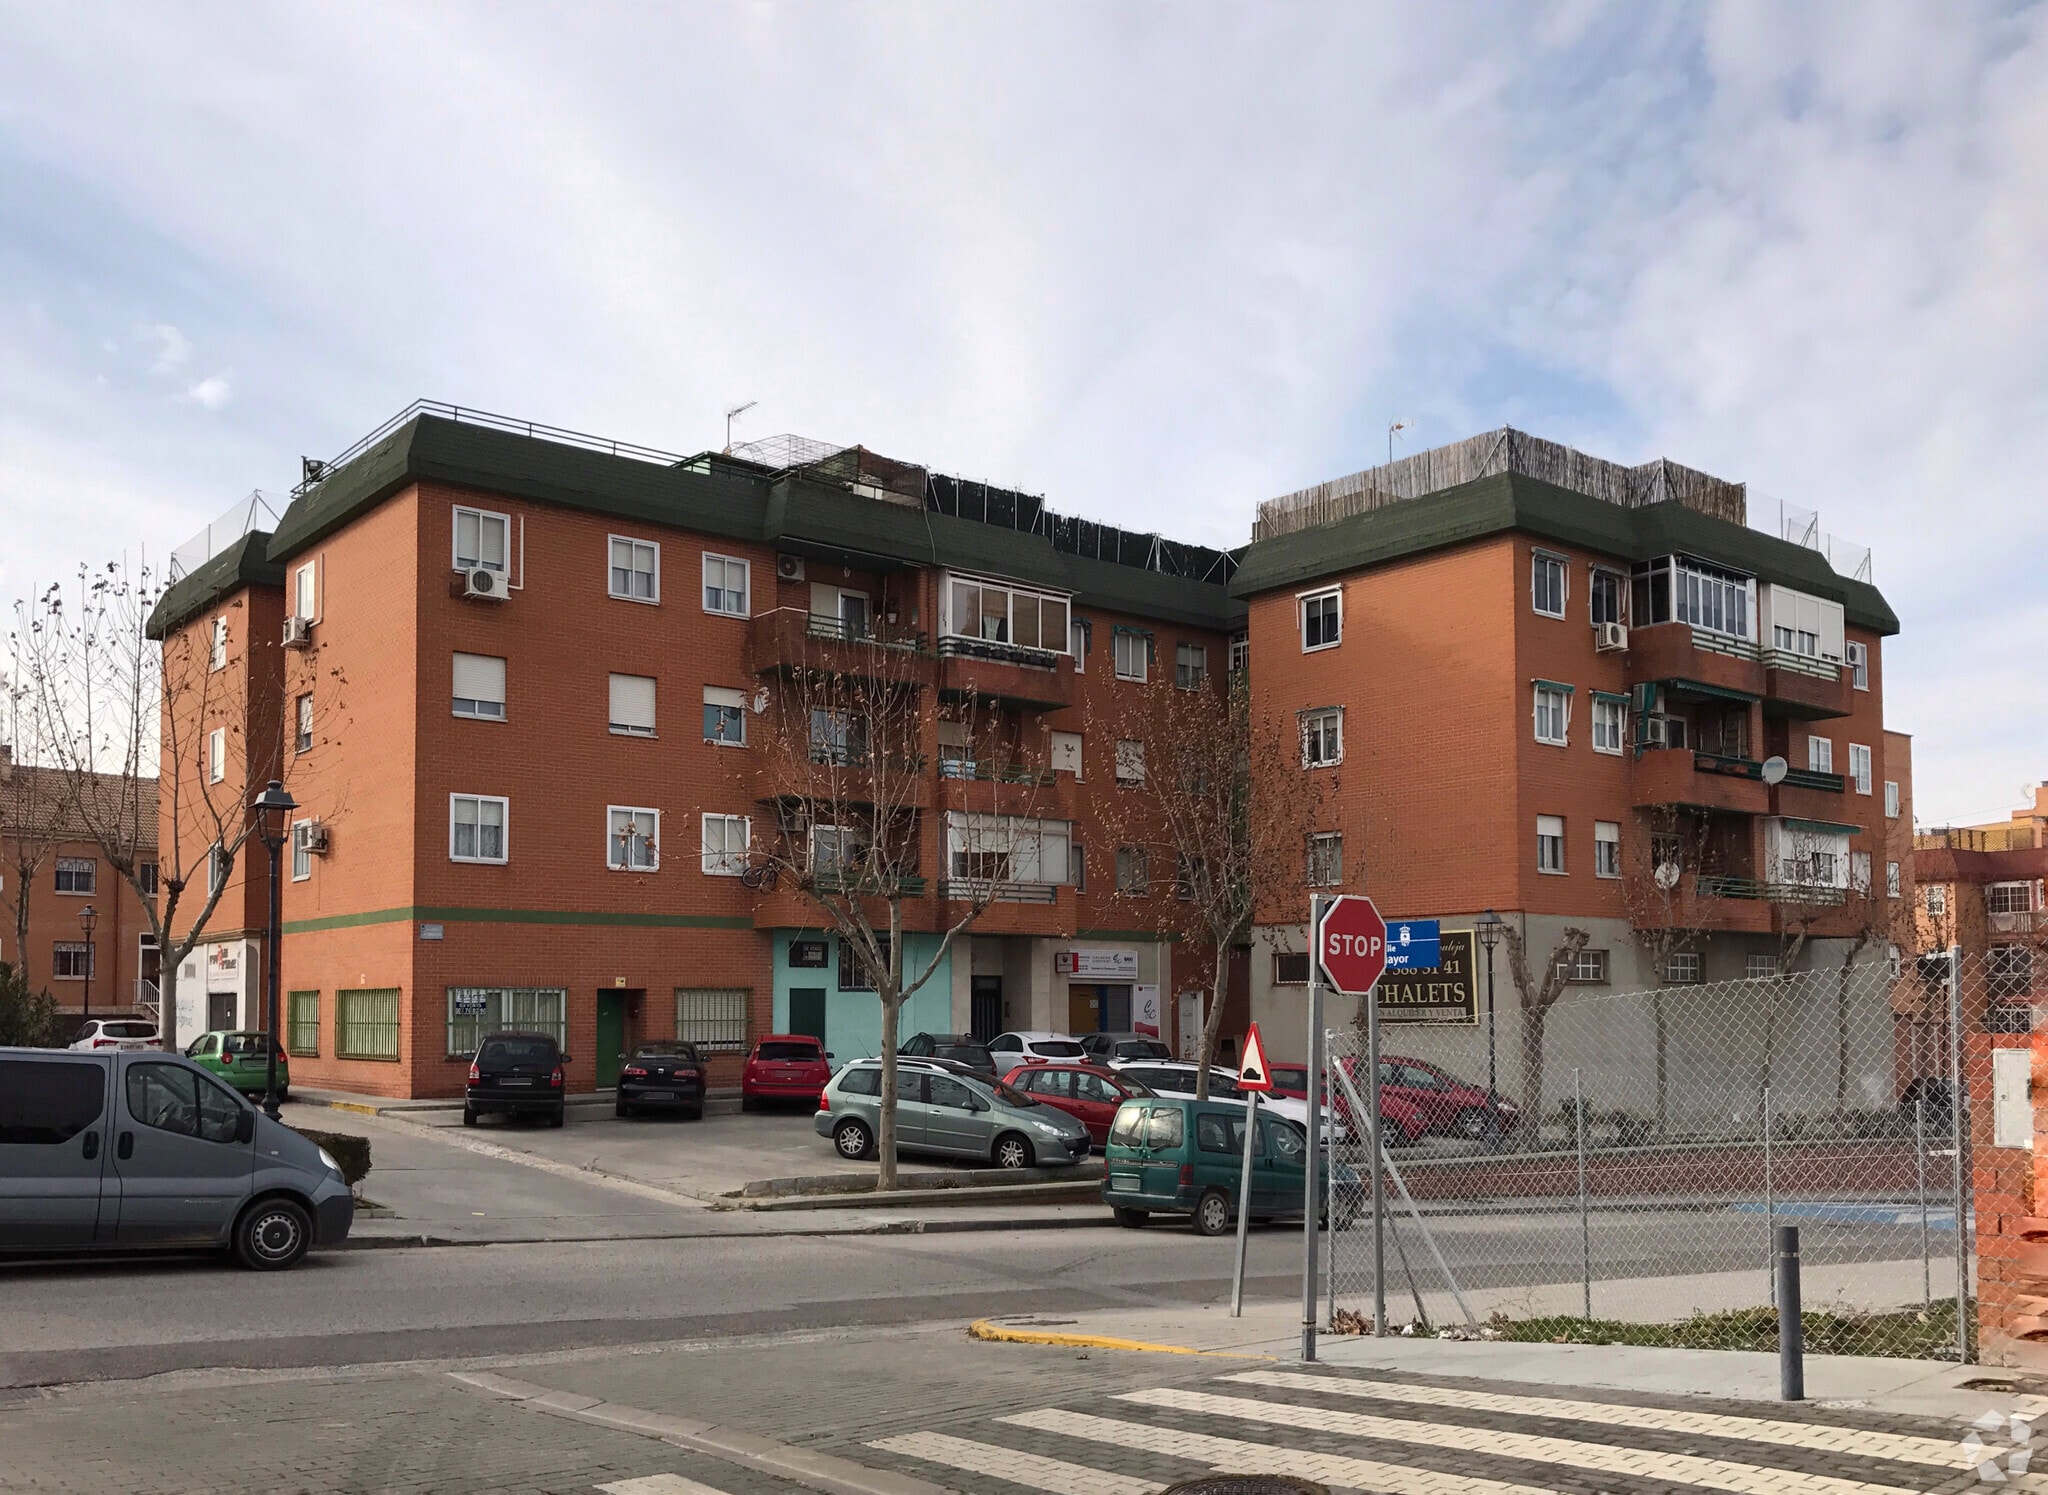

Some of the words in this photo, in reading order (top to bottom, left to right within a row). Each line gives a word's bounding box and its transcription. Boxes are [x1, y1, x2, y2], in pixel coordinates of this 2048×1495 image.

[1329, 933, 1381, 957] STOP
[1387, 944, 1396, 952] lle
[1387, 955, 1409, 966] ayor
[1443, 960, 1462, 974] 41
[1387, 1009, 1427, 1017] ALQUILER
[1428, 1009, 1433, 1017] Y
